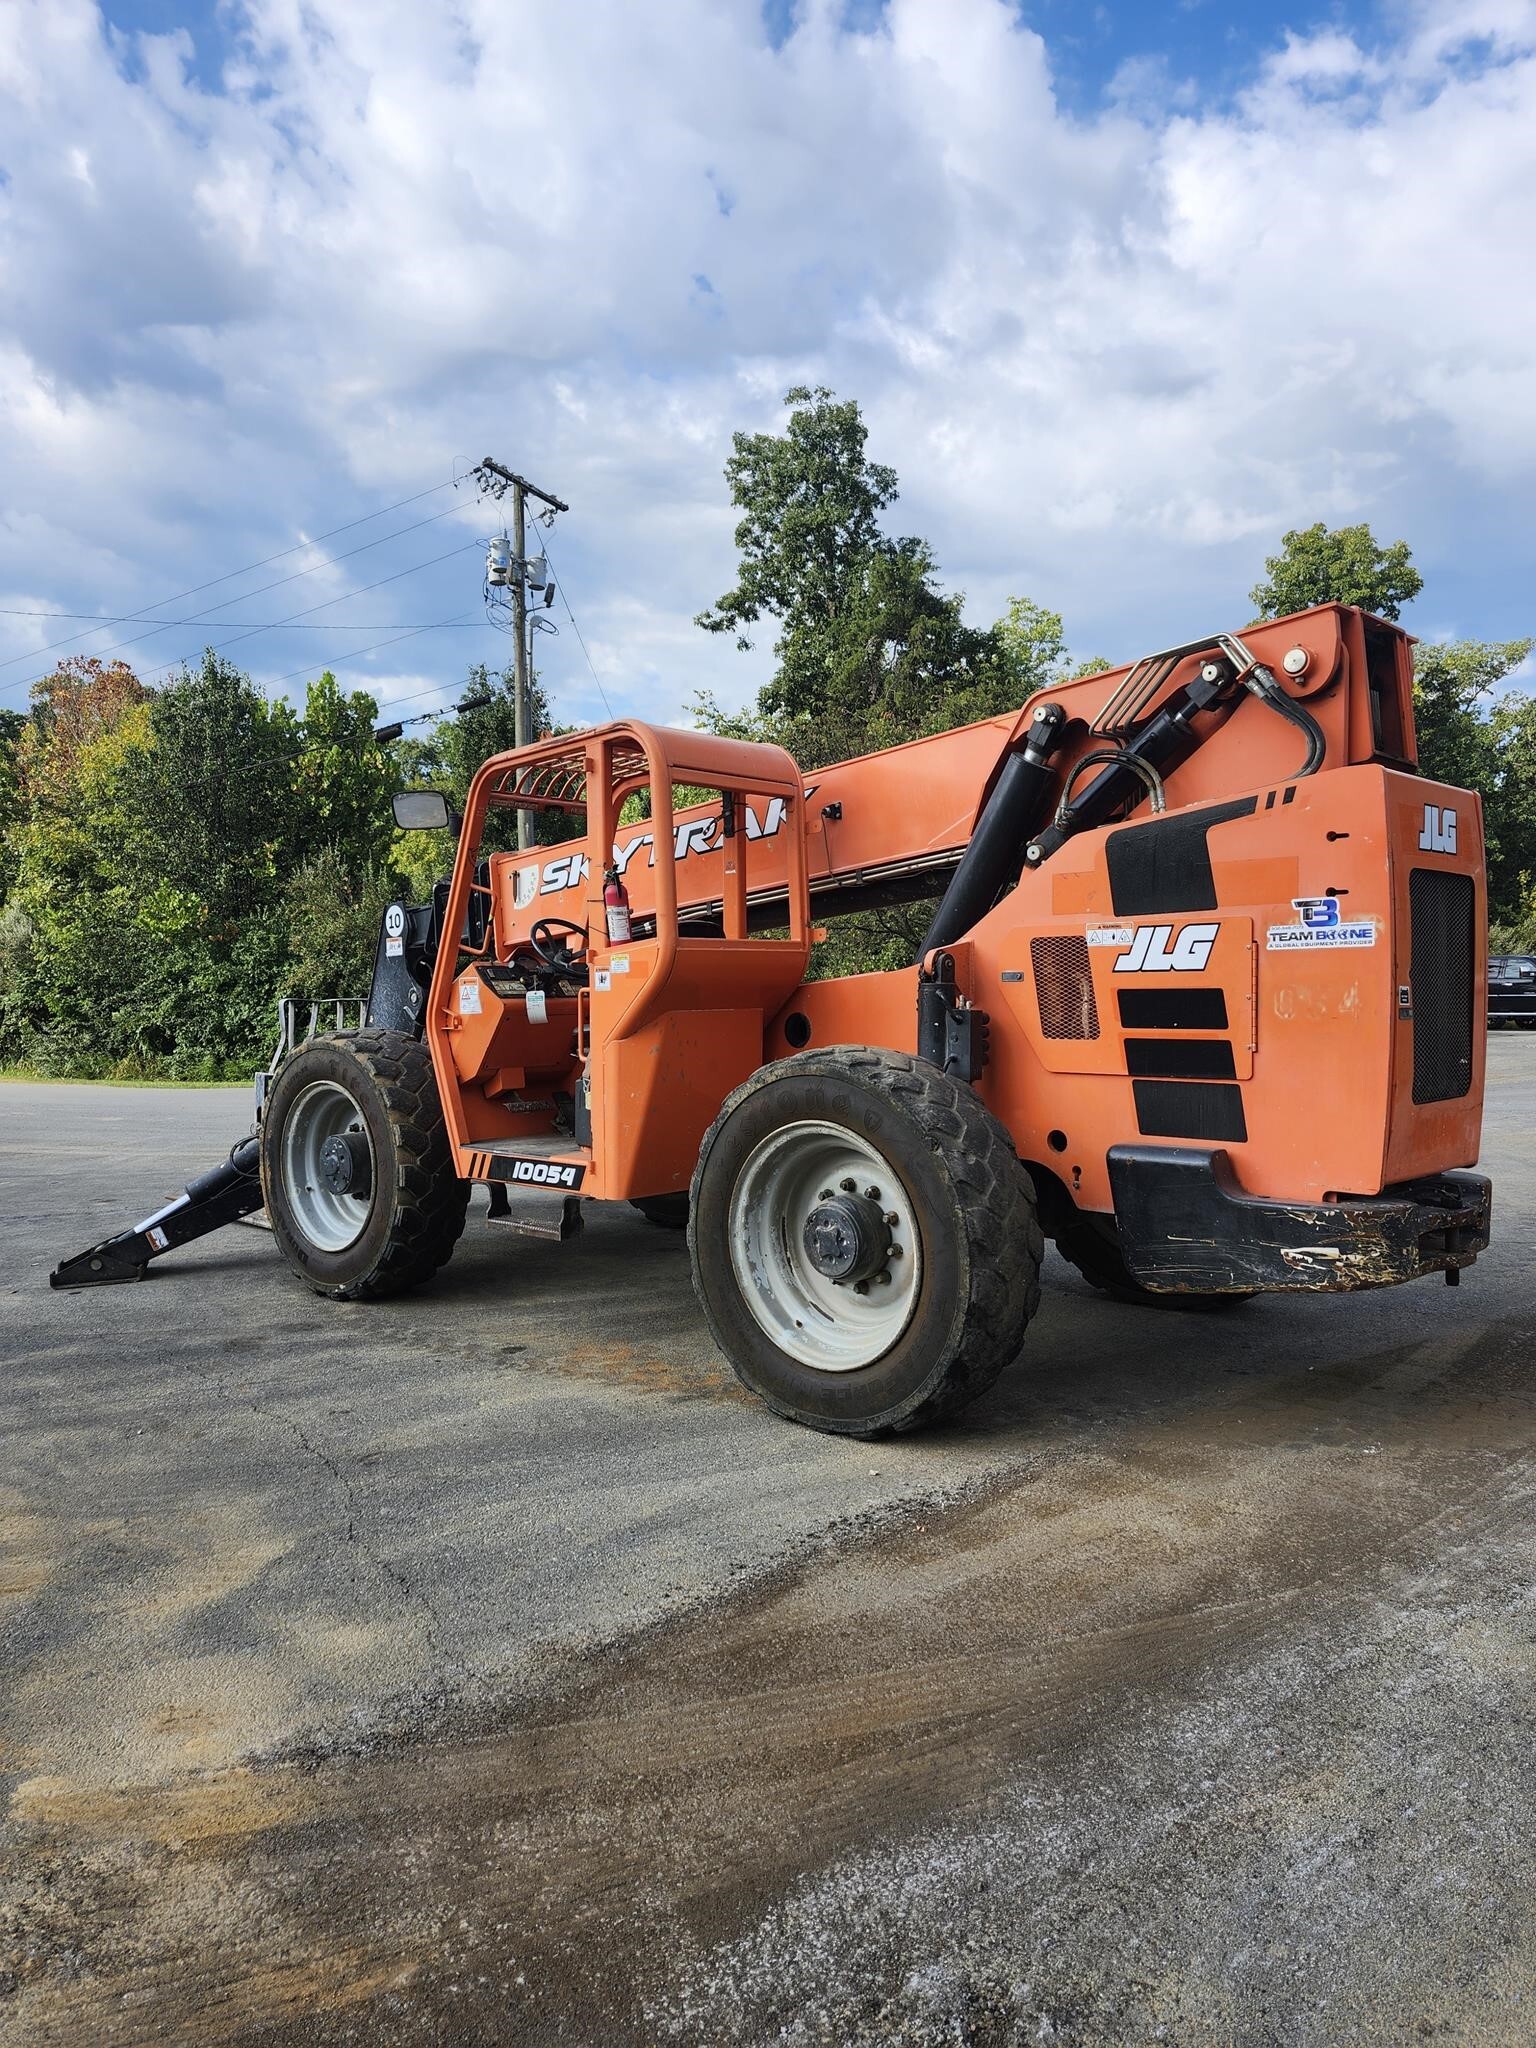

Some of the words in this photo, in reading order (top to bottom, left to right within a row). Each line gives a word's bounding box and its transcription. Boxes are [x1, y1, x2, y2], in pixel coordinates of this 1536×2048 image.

[1418, 803, 1458, 856] JLG
[389, 913, 401, 928] 10
[1112, 922, 1221, 973] JLG
[1269, 931, 1313, 942] TEAM
[512, 1161, 577, 1187] 10054
